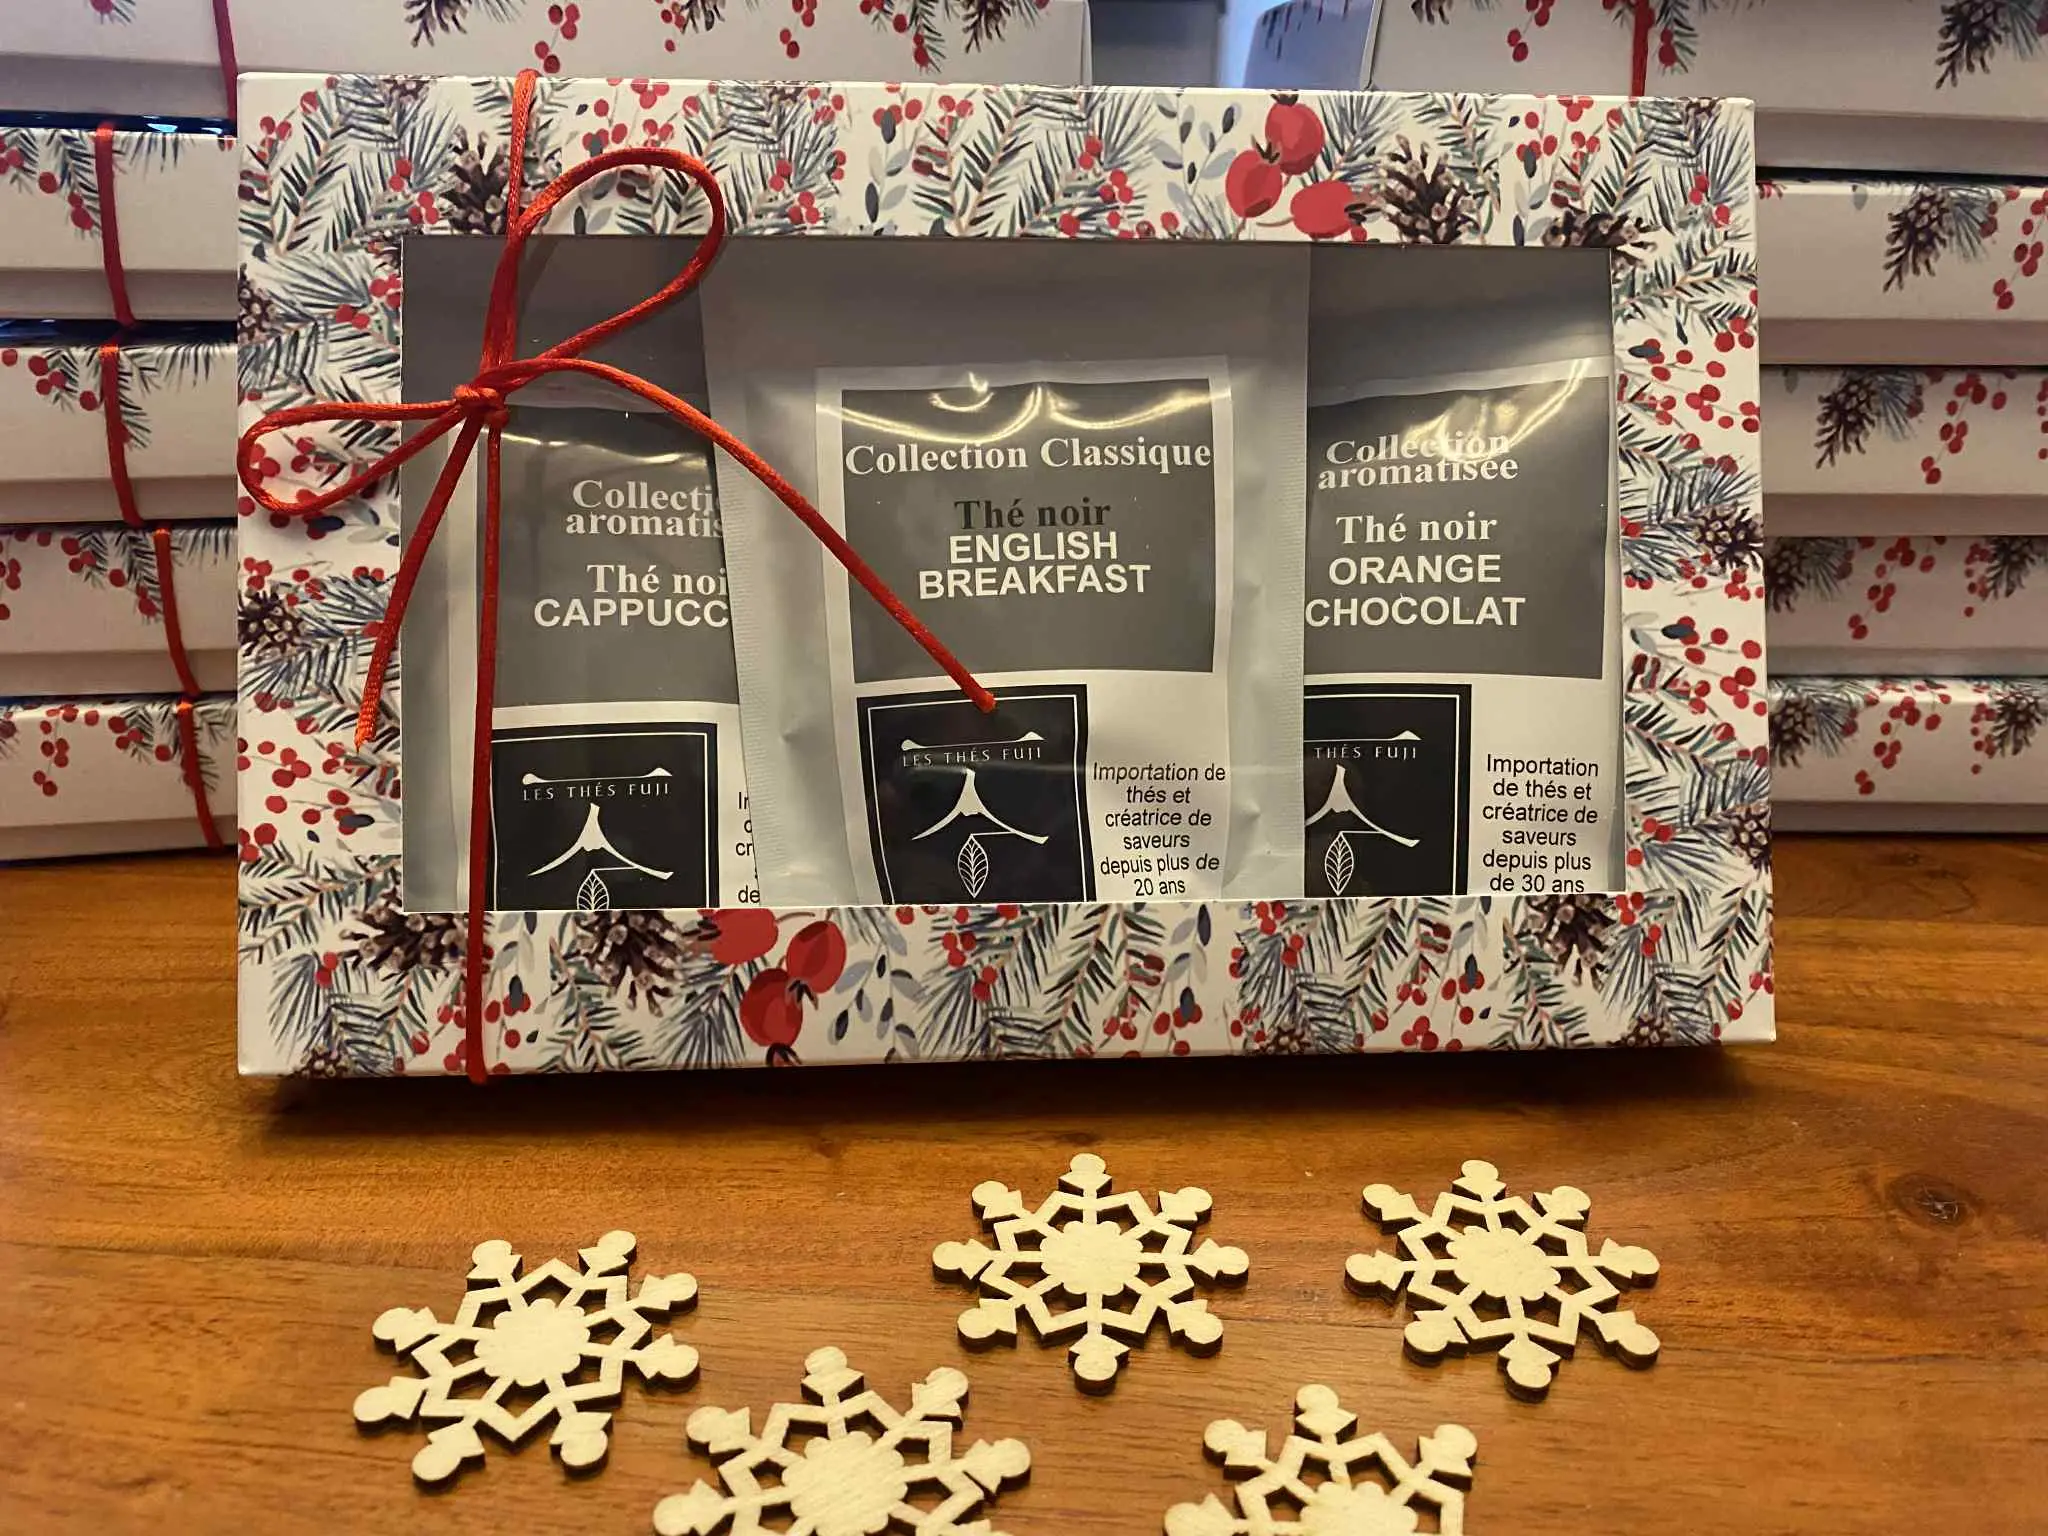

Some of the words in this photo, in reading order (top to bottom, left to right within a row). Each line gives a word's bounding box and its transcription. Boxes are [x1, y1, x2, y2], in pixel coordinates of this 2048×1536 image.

[846, 442, 1028, 475] Collection
[1040, 436, 1212, 474] Classique
[1326, 430, 1511, 464] Collection
[954, 498, 1025, 530] Thé
[1038, 496, 1111, 527] noir
[1336, 513, 1407, 544] Thé
[1420, 511, 1498, 542] noir
[949, 531, 1118, 565] ENGLISH
[586, 564, 660, 593] Thé
[918, 564, 1151, 600] BREAKFAST
[1328, 554, 1501, 586] ORANGE
[534, 598, 729, 628] CAPPUCC
[1305, 596, 1526, 628] CHOCOLAT
[903, 753, 932, 768] LES
[944, 746, 990, 764] THÉS
[1002, 746, 1041, 762] FUJI
[1314, 743, 1361, 759] THÉS
[1375, 746, 1417, 761] FUJI
[1093, 762, 1199, 784] Importation
[1204, 763, 1225, 782] de
[1487, 753, 1599, 778] Importation
[523, 787, 555, 802] LES
[567, 782, 616, 799] THÉS
[629, 783, 669, 797] FUJI
[1127, 785, 1167, 804] thés
[1173, 787, 1191, 804] et
[1493, 778, 1519, 797] de
[1525, 779, 1568, 799] thés
[1573, 783, 1592, 800] et
[1105, 808, 1182, 827] créatrice
[1188, 809, 1212, 827] de
[1483, 802, 1569, 823] créatrice
[1574, 804, 1598, 823] de
[1123, 833, 1190, 850] saveurs
[1502, 828, 1576, 846] saveurs
[1100, 857, 1152, 879] depuis
[1157, 855, 1190, 876] plus
[1195, 853, 1220, 871] de
[1483, 849, 1548, 872] depuis
[1554, 851, 1591, 873] plus
[1134, 878, 1154, 897] 20
[1159, 881, 1186, 895] ans
[1490, 872, 1514, 892] de
[1522, 875, 1545, 893] 30
[1552, 879, 1584, 893] ans
